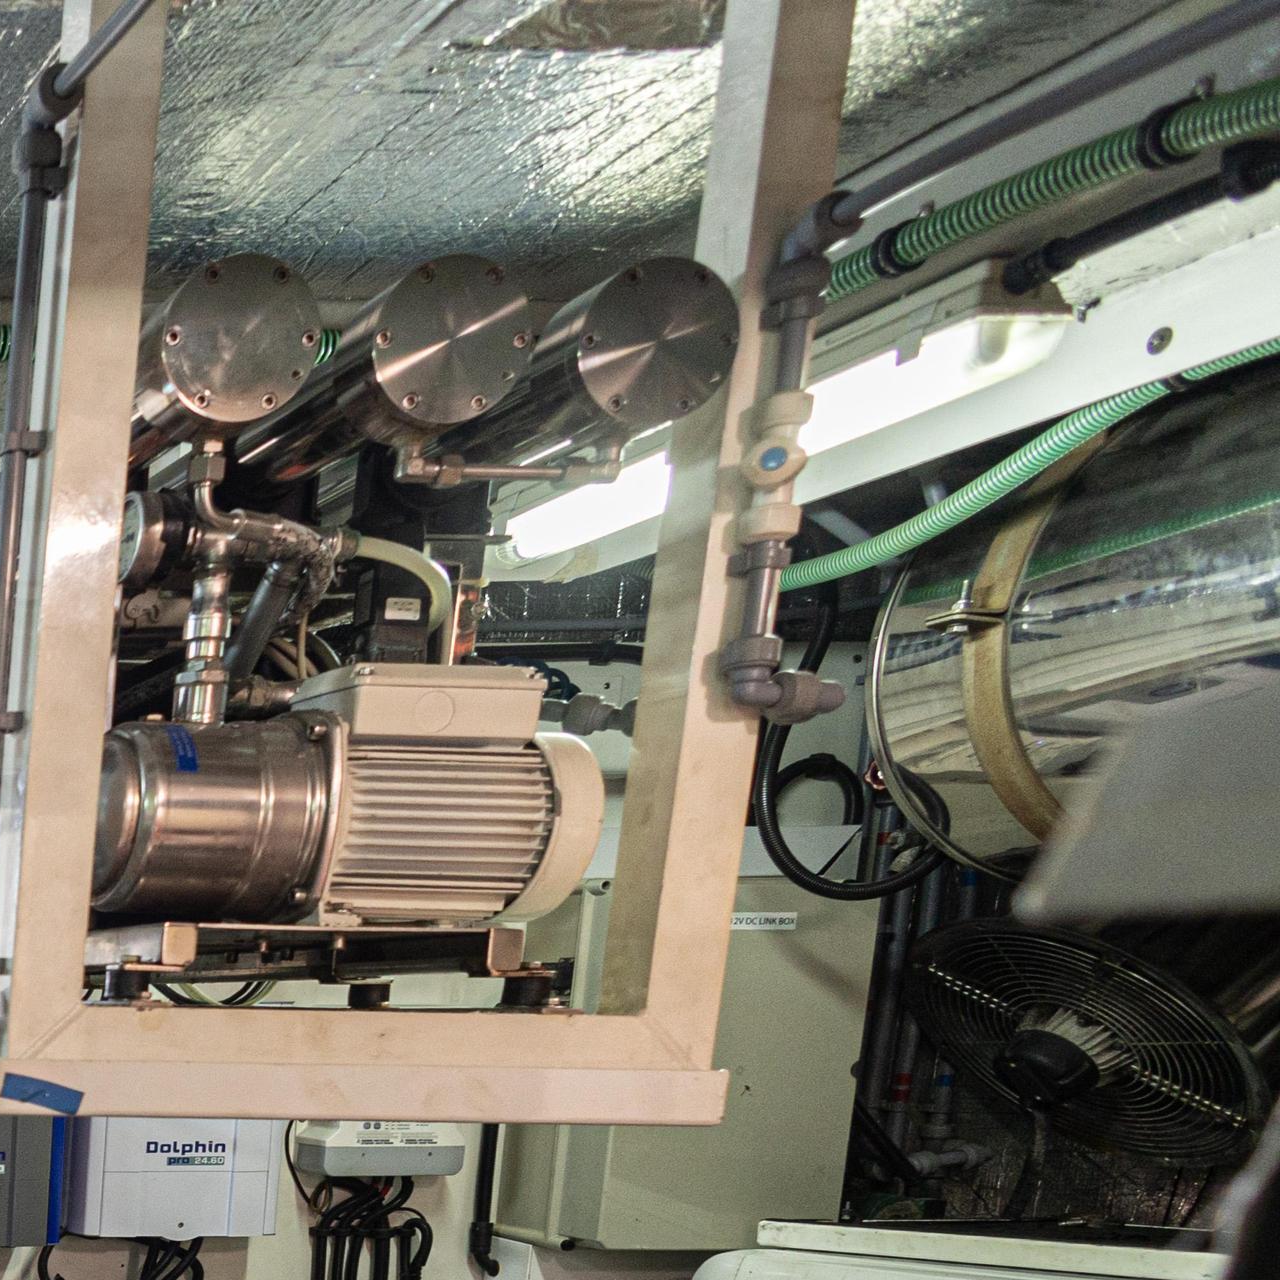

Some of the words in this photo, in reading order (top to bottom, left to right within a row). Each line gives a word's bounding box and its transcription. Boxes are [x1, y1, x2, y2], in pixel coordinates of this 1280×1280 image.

[746, 917, 758, 926] DC
[759, 917, 777, 926] LINK
[779, 917, 795, 926] BOX
[146, 1140, 226, 1156] Dolphin
[167, 1156, 190, 1166] pro
[194, 1156, 225, 1166] 24.60
